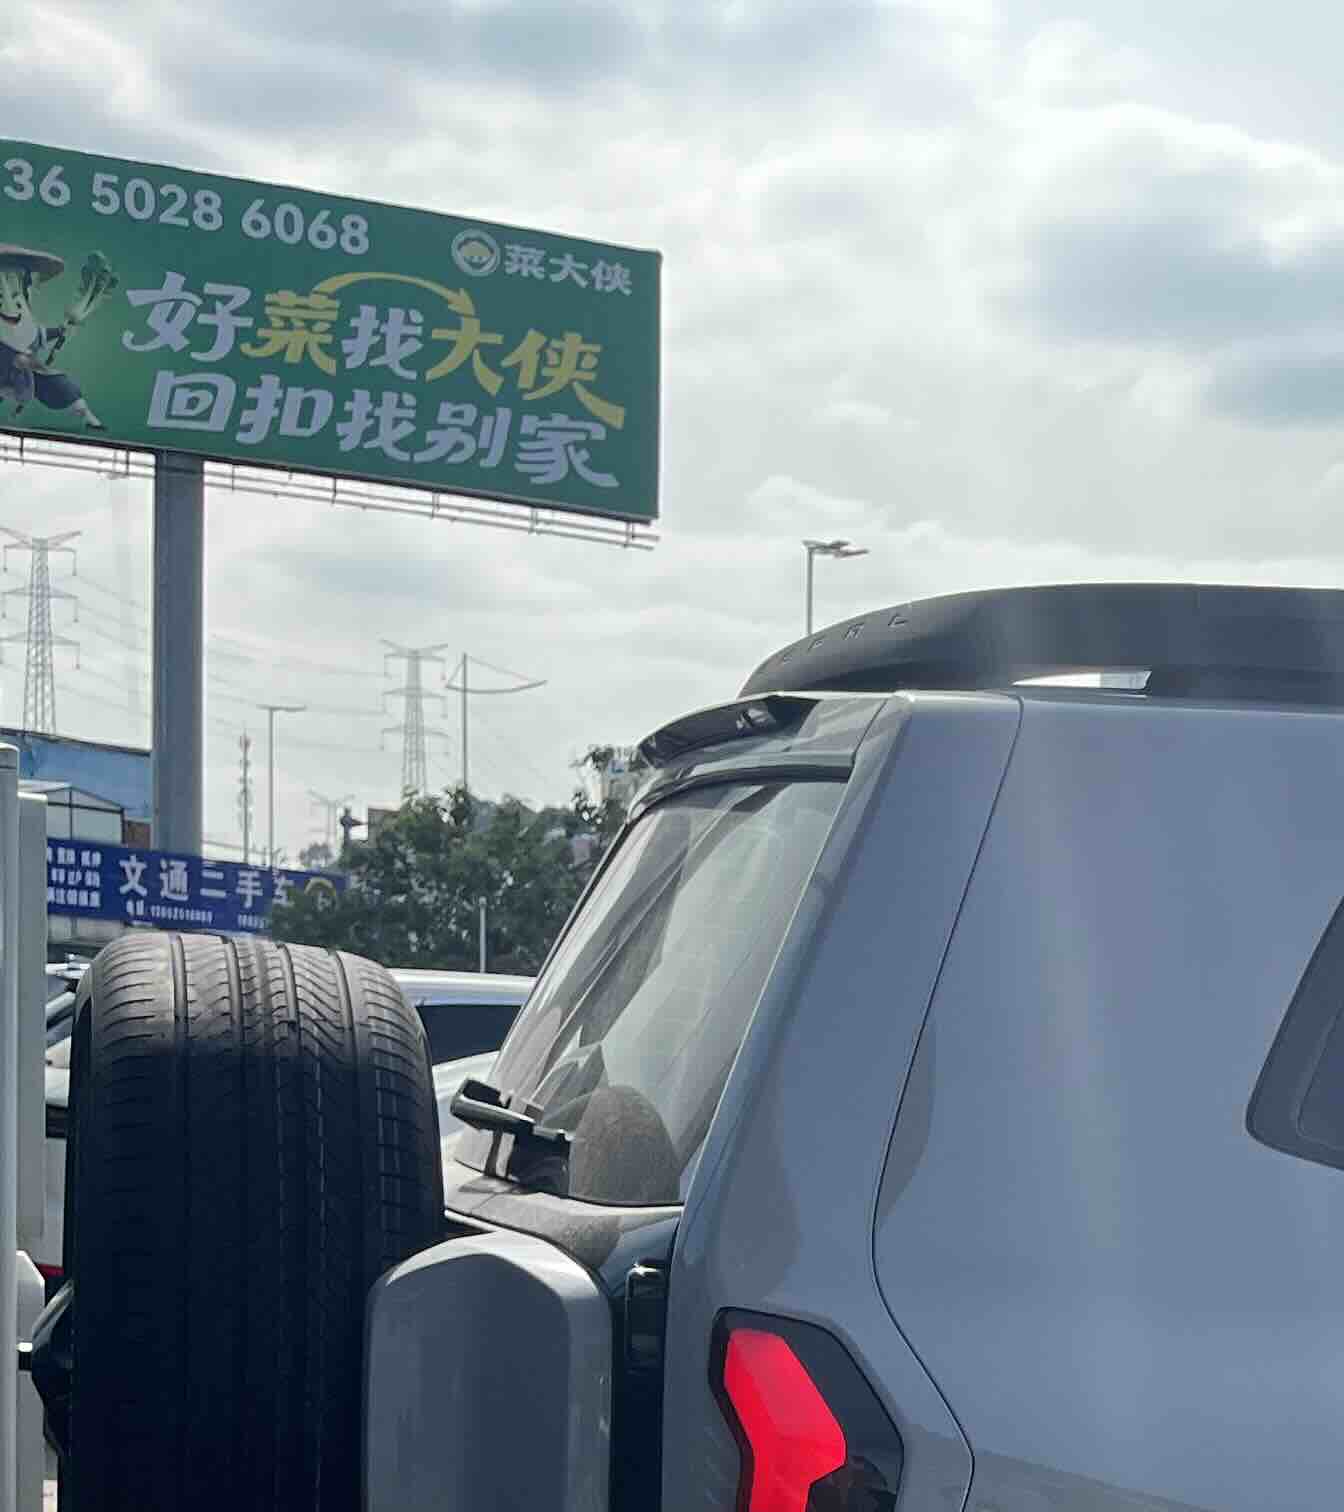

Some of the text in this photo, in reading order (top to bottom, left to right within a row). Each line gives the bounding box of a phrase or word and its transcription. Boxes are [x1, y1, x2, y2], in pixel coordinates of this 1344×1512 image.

[3, 158, 370, 255] 36 5028 6068
[504, 243, 633, 297] 菜大侠
[121, 271, 626, 430] 好菜找大侠
[146, 369, 620, 488] 回扣找别家
